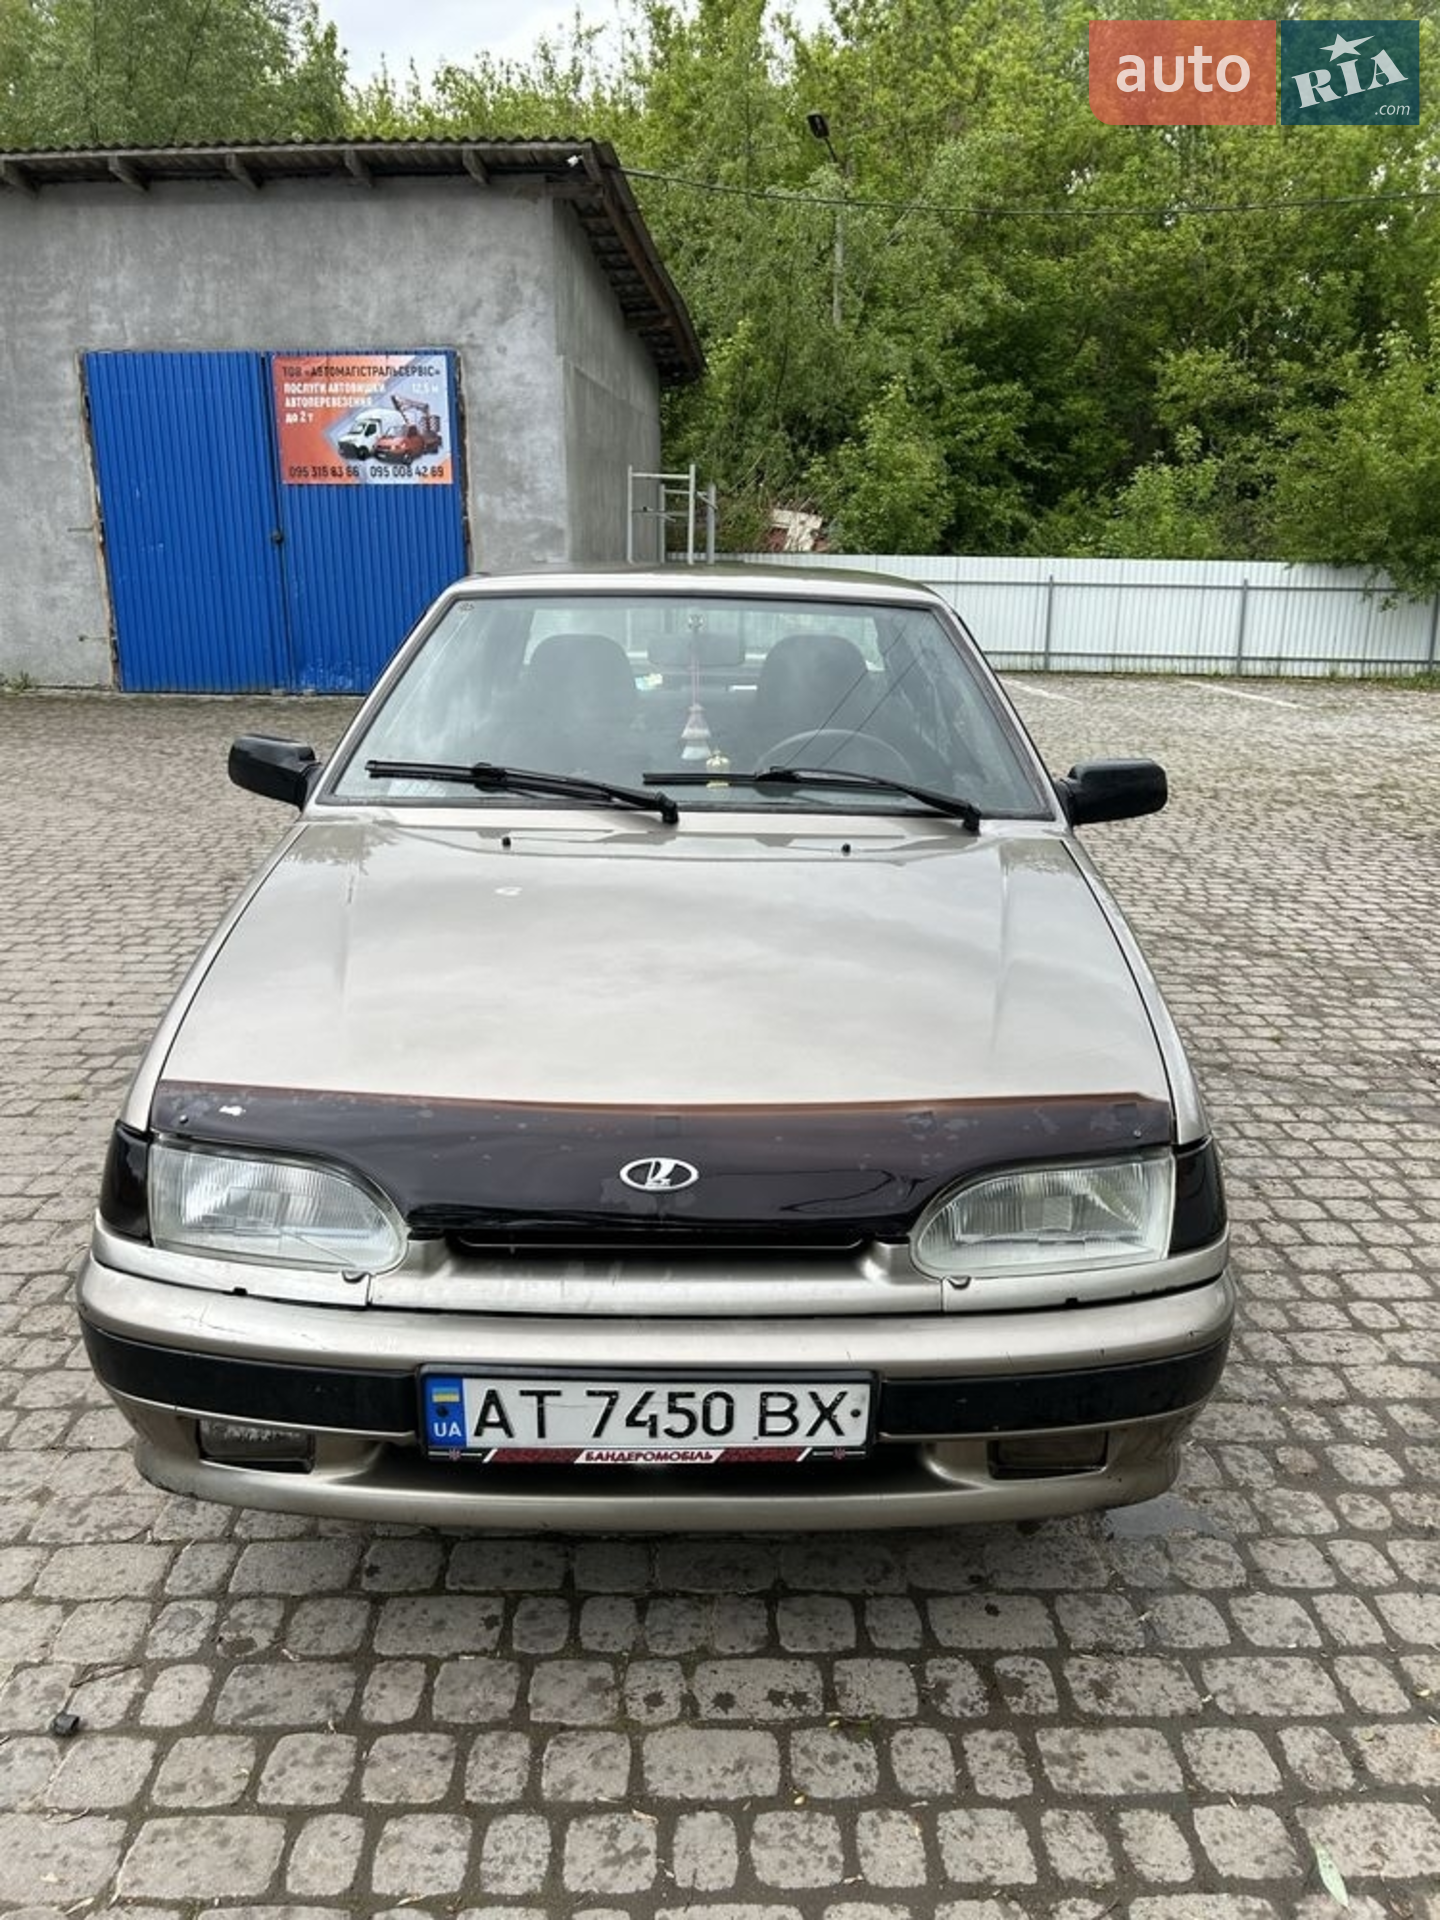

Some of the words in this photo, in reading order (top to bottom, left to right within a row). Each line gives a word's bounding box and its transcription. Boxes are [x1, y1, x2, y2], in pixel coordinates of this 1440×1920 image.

[282, 366, 302, 377] ТОВ
[284, 383, 326, 394] ПОСЛУГИ
[285, 413, 298, 423] до
[300, 411, 306, 423] 2
[289, 466, 309, 478] 095
[370, 466, 390, 478] 095
[415, 466, 428, 478] 42
[473, 1388, 562, 1439] AT
[586, 1389, 735, 1439] 7450
[757, 1391, 848, 1438] BX
[434, 1422, 461, 1438] UA
[585, 1450, 713, 1462] БАНДЕРОМОБІЛЬ
